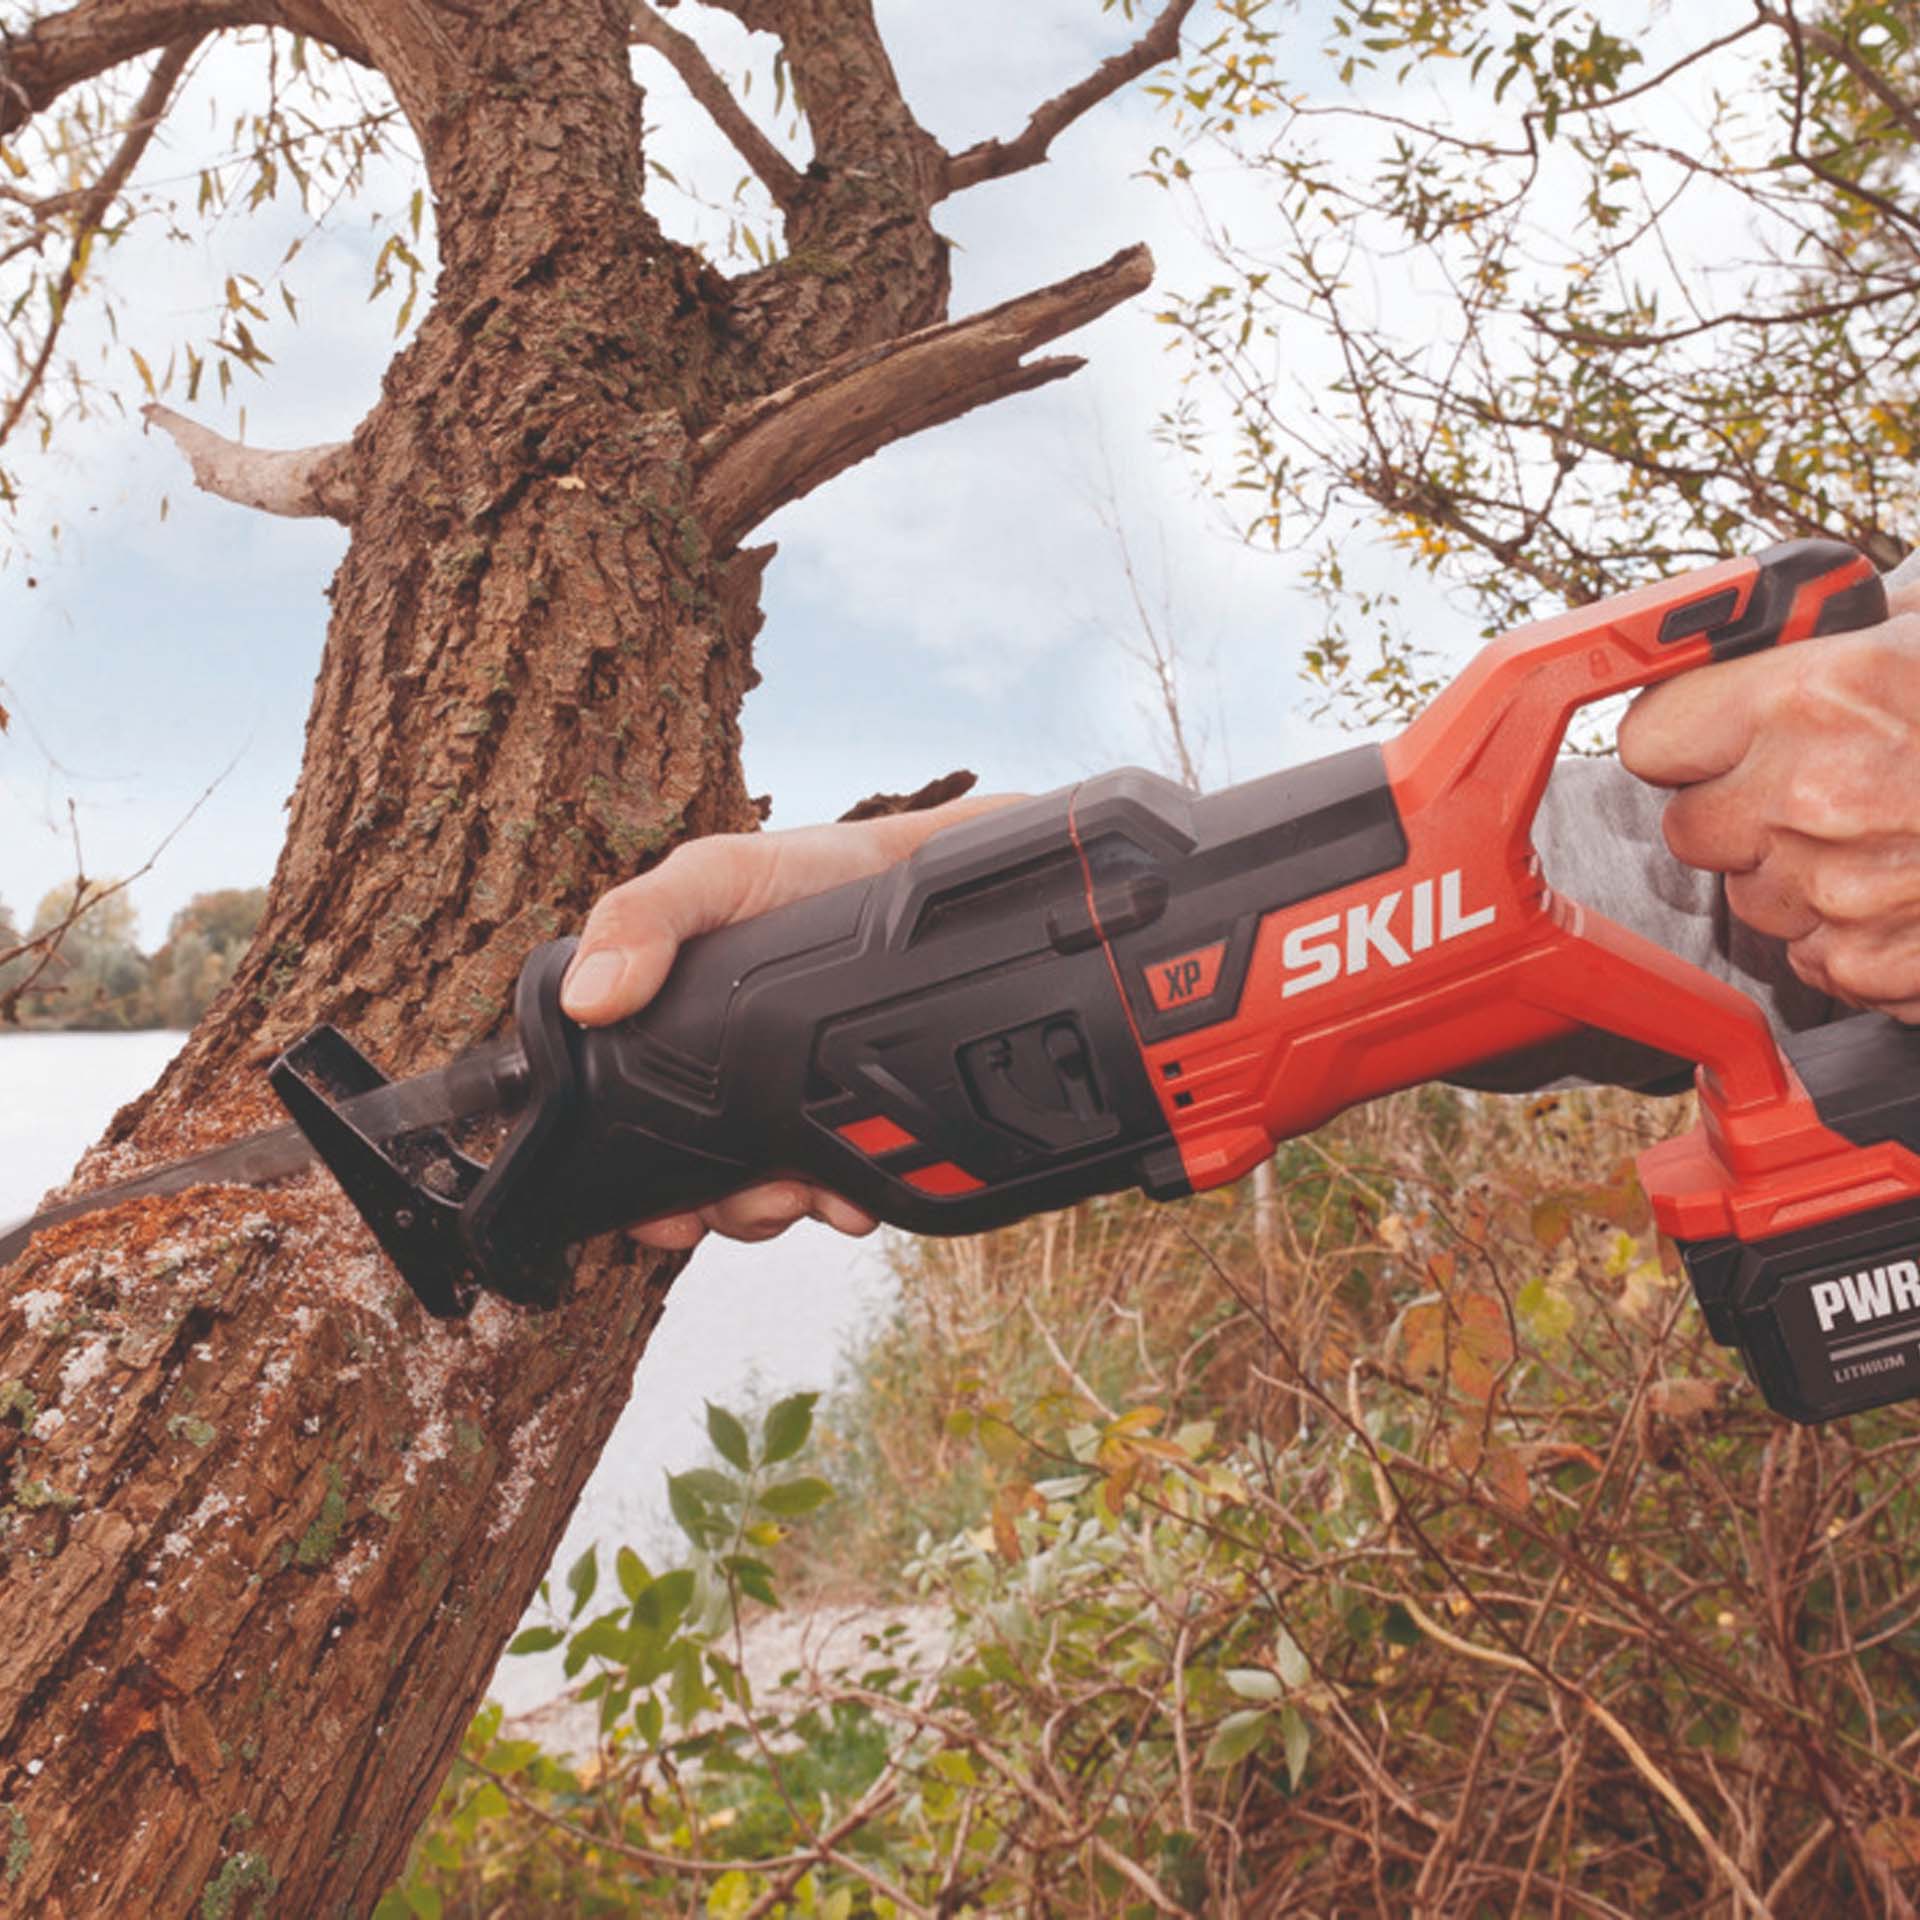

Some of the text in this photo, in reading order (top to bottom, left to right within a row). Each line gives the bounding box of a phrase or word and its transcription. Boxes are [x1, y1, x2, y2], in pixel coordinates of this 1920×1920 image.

[1281, 868, 1496, 999] SKIL
[1163, 960, 1201, 1001] XP
[1810, 1259, 1920, 1332] PWR
[1833, 1353, 1905, 1383] LITHIUM
